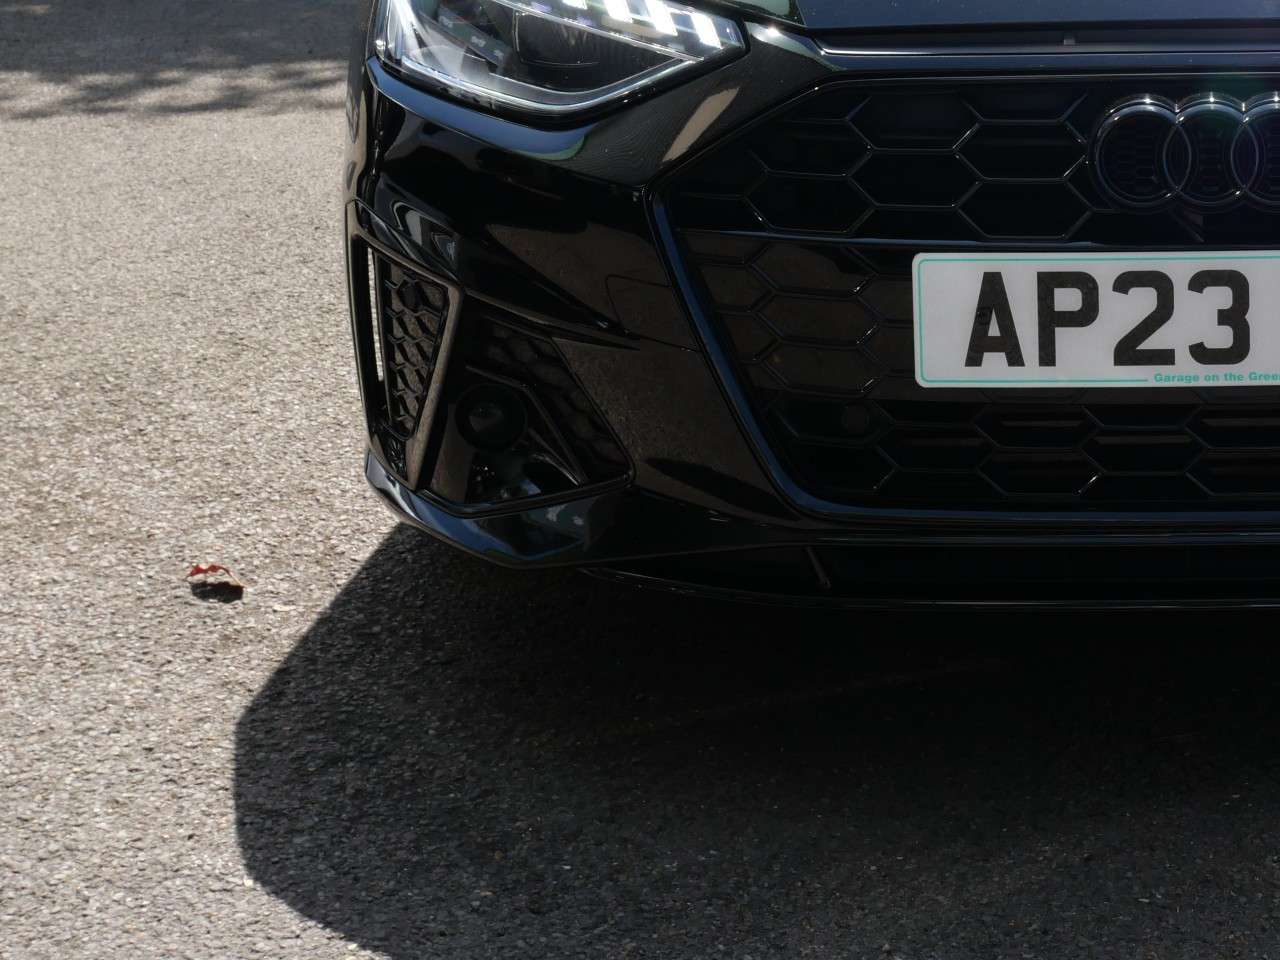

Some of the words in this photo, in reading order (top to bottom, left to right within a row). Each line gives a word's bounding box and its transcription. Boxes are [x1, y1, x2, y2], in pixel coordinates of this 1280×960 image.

[964, 268, 1251, 368] AP23
[1153, 373, 1199, 383] Garage
[1204, 373, 1220, 382] on
[1224, 372, 1244, 382] the
